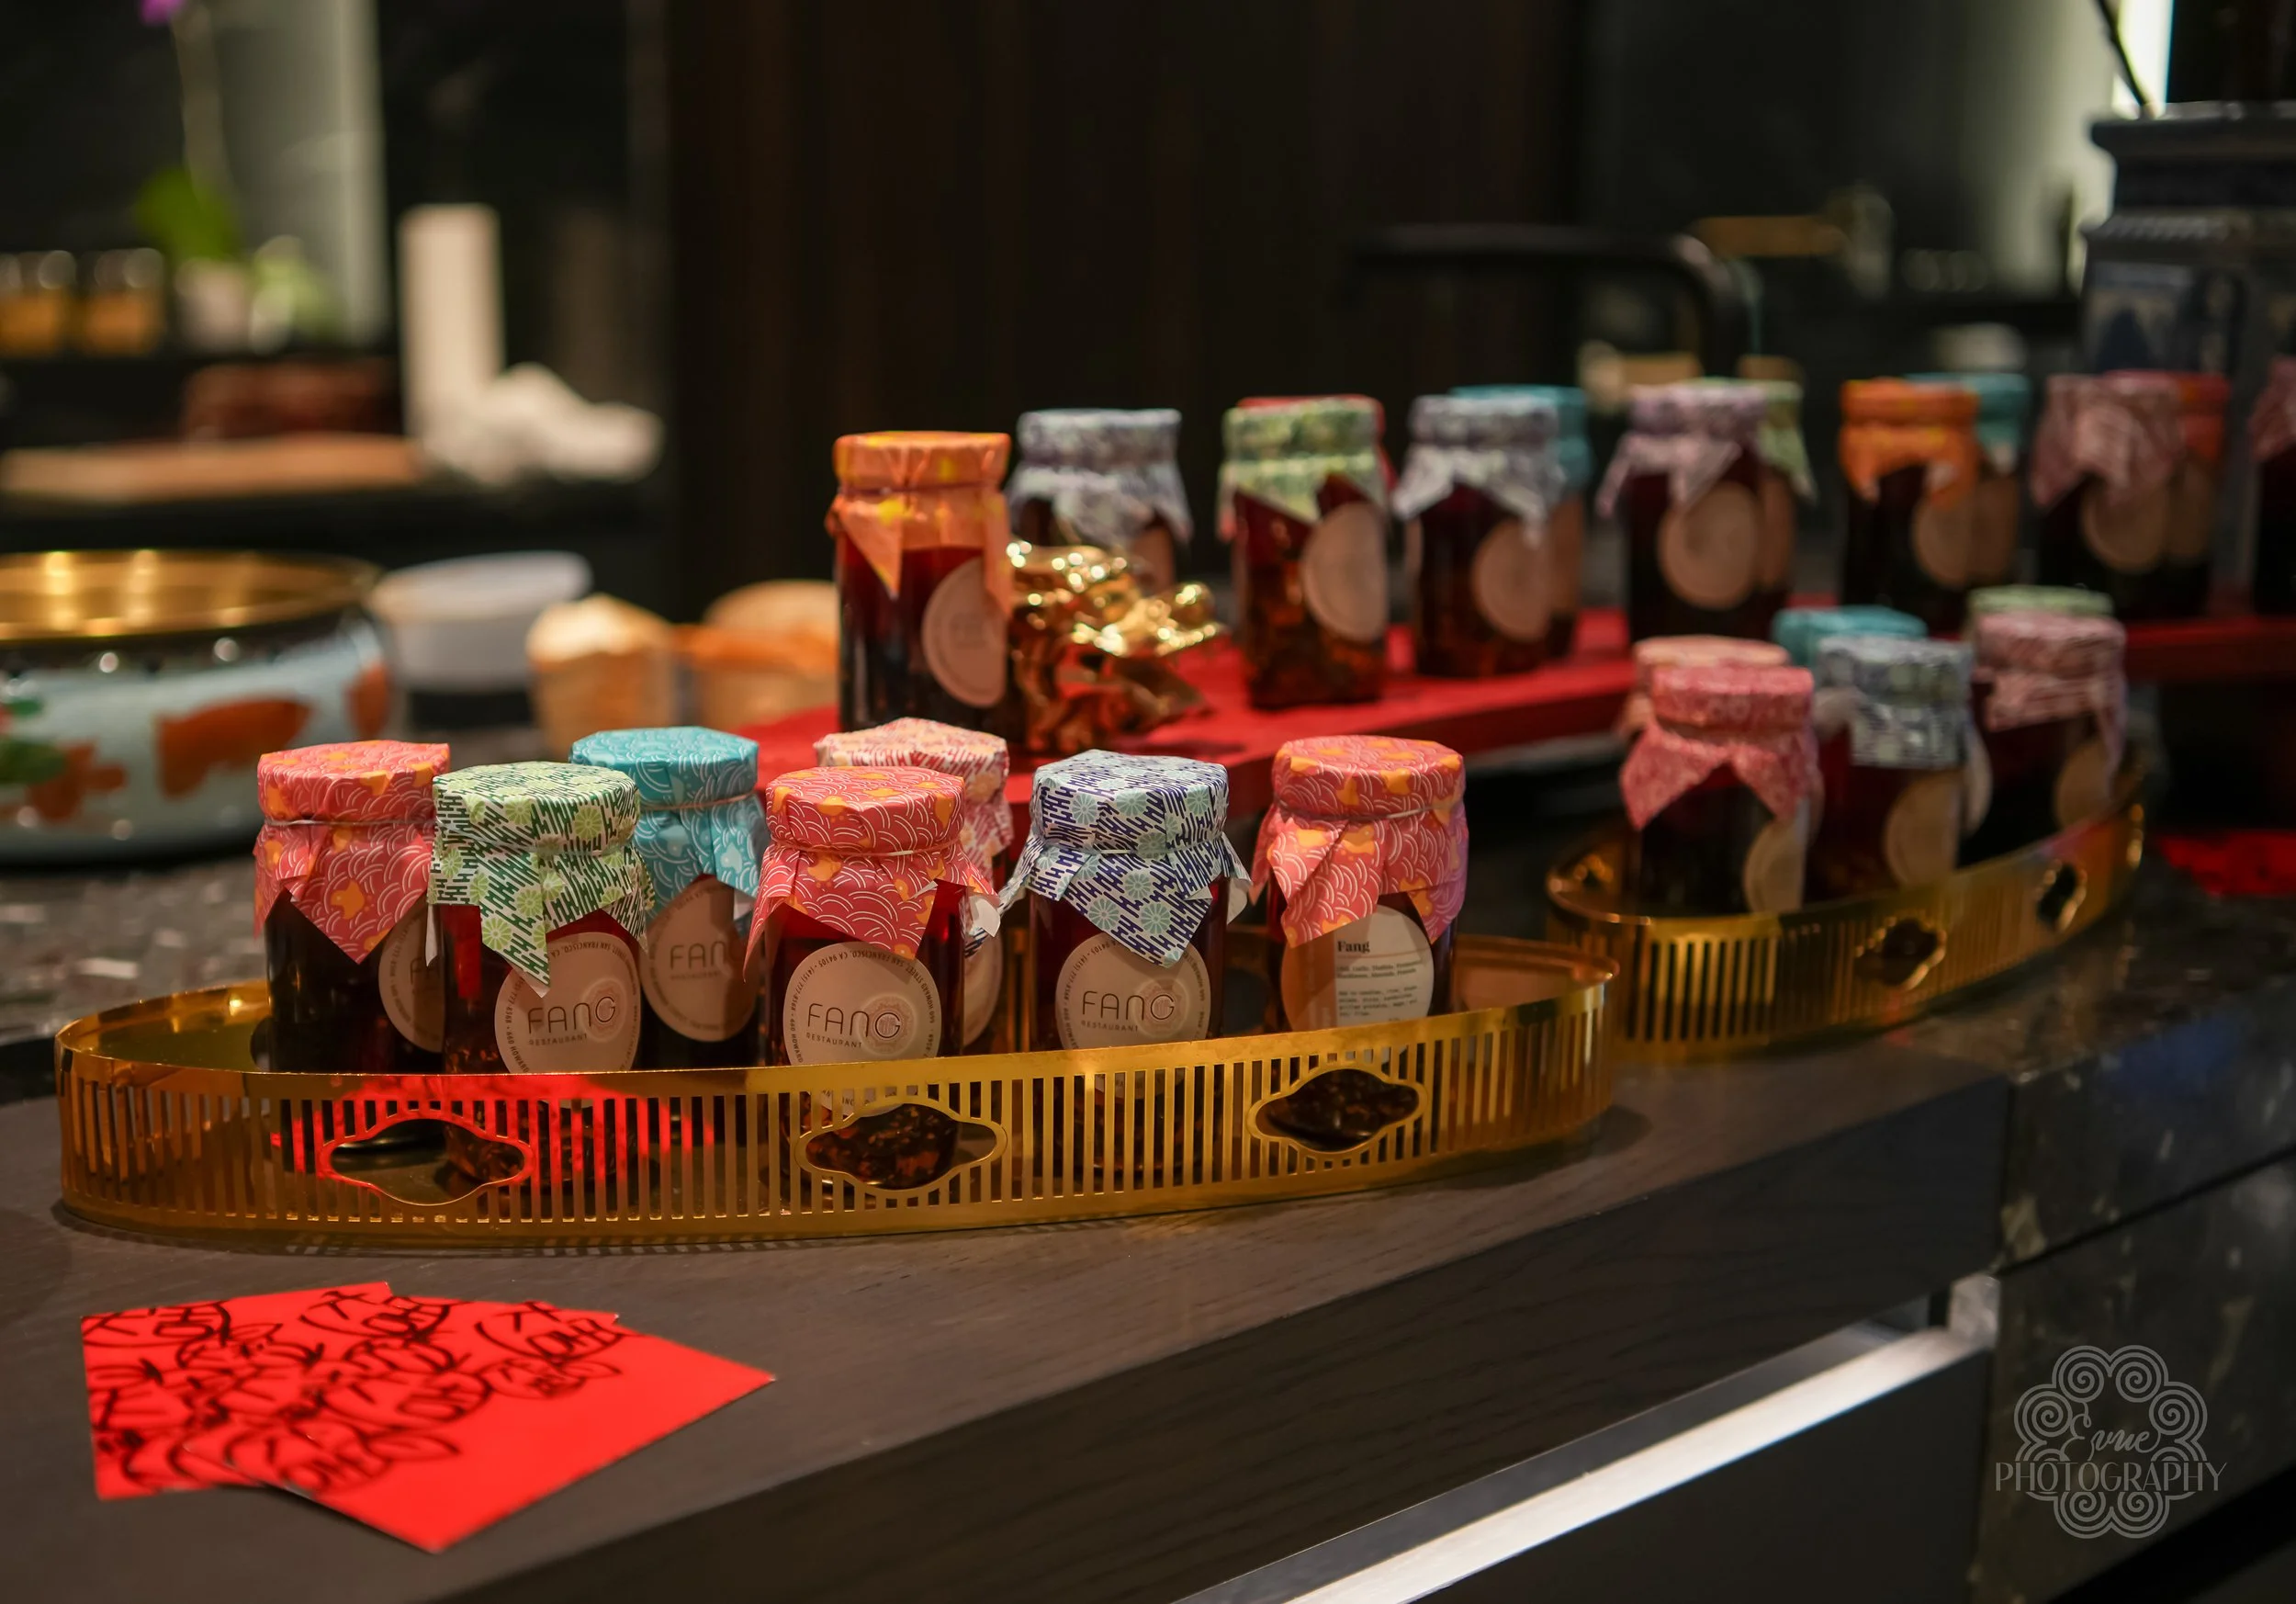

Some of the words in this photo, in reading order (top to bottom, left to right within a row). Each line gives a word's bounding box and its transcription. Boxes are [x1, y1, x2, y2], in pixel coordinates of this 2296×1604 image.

[1336, 940, 1371, 954] Fang
[670, 940, 728, 970] FAN
[818, 954, 838, 967] 94105
[838, 952, 849, 961] CA
[1082, 990, 1176, 1022] FANG
[527, 996, 616, 1034] FANG
[807, 1002, 901, 1039] FANG
[1081, 1020, 1139, 1032] RESTAURANT
[529, 1033, 588, 1046] RESTAURANT
[806, 1033, 862, 1049] RESTAURANT
